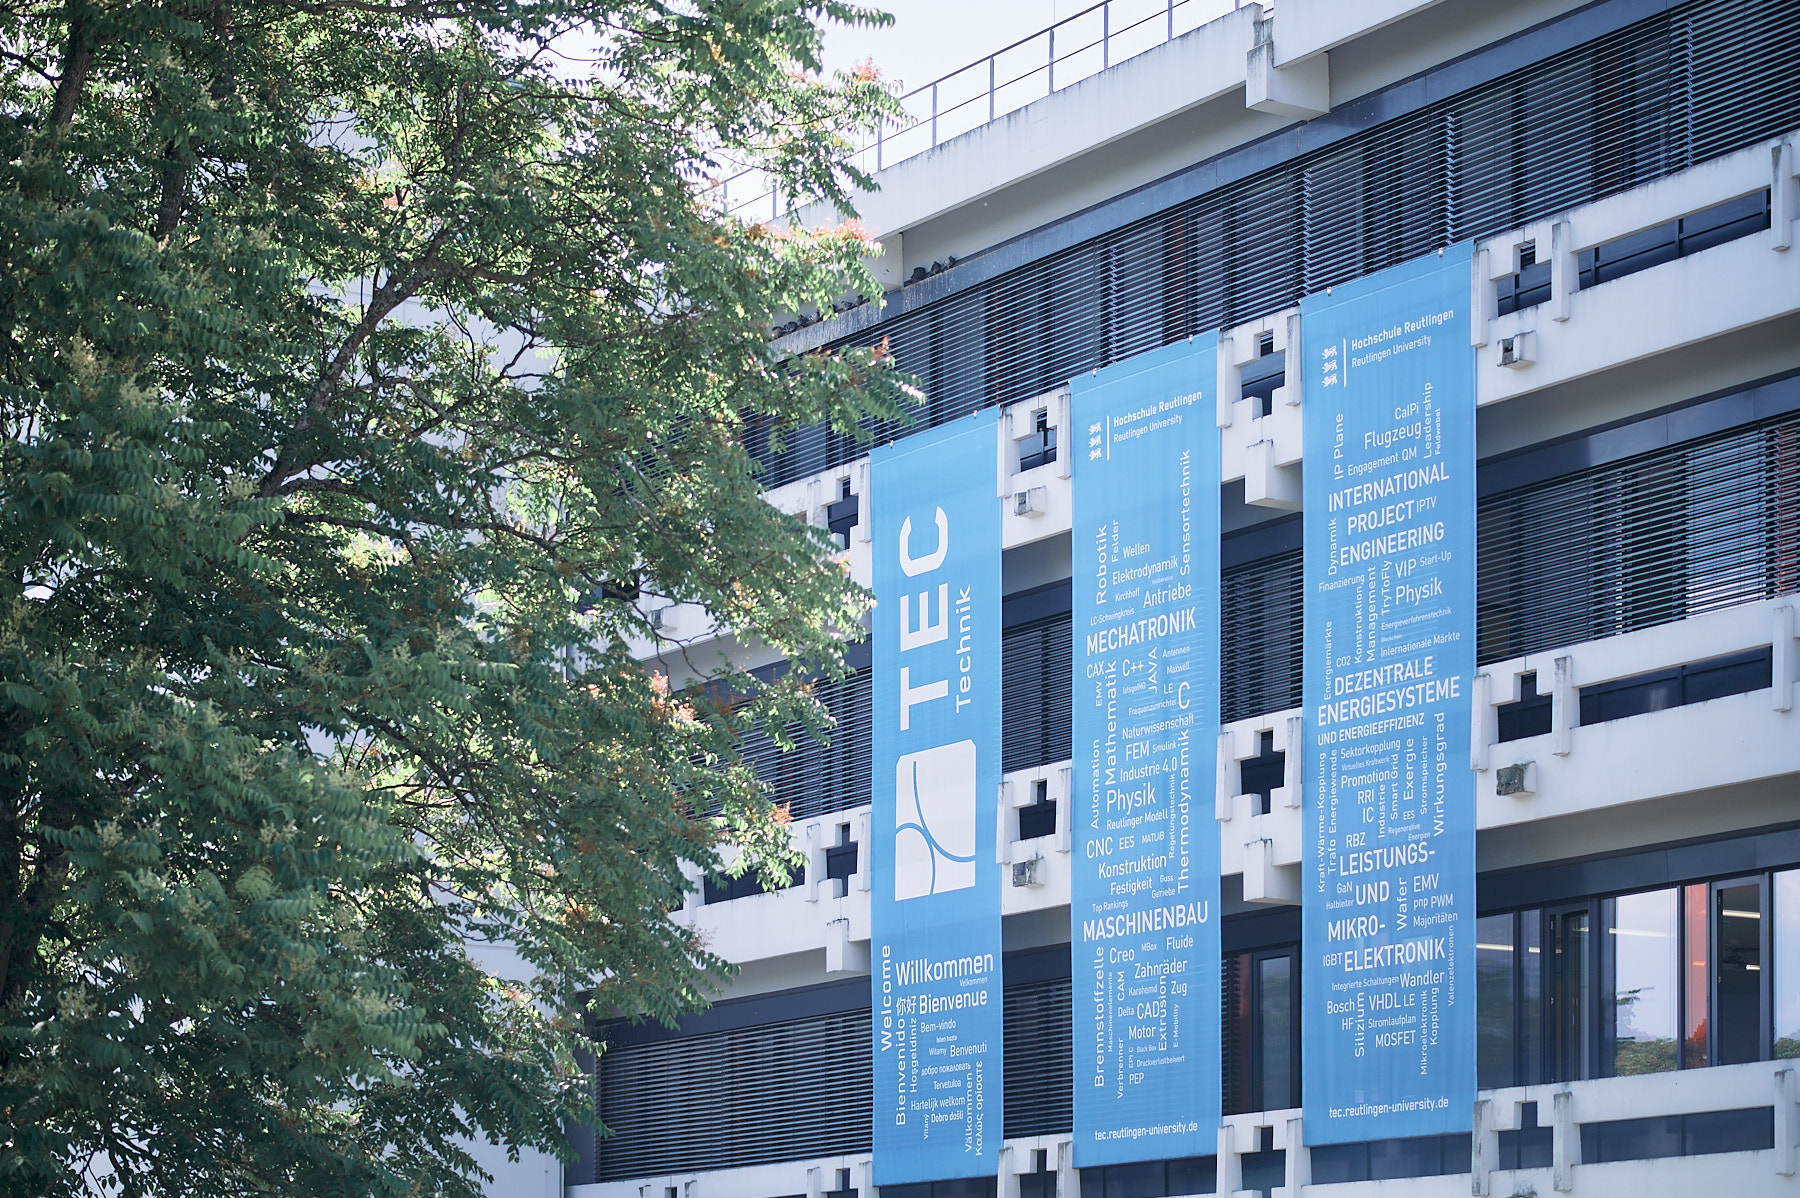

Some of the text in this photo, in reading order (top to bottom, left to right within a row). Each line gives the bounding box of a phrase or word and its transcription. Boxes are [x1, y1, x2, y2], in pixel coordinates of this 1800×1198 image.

[1351, 309, 1454, 350] Hochschule Reutlingen
[1351, 335, 1432, 368] Reutlingen University
[1114, 391, 1202, 427] Hochschule Reutlingen
[1423, 382, 1434, 459] Leadership
[1114, 414, 1183, 443] Reutlingen University
[1364, 421, 1422, 449] Flugzeug
[1334, 413, 1344, 480] IP Plane
[1401, 446, 1417, 461] QM
[1348, 452, 1399, 476] Engagement
[1328, 461, 1450, 512] INTERNATIONAL
[1180, 449, 1190, 576] Sensortechnik
[1416, 496, 1437, 513] IPTV
[1348, 500, 1415, 536] PROJECT
[1123, 543, 1150, 559] Wellen
[1328, 517, 1338, 576] Dynamik
[1340, 521, 1445, 566] ENGINEERING
[1096, 524, 1107, 605] Robotik
[1112, 555, 1178, 585] Elektrodynamik
[1395, 558, 1417, 579] VIP
[1420, 551, 1452, 567] Start-Up
[1115, 587, 1140, 602] Kirchhoff
[1143, 582, 1192, 608] Antriebe
[1318, 574, 1365, 592] Finanzierung
[1381, 560, 1392, 617] TryToFly
[1395, 576, 1443, 606] Physik
[900, 505, 949, 732] TEC
[1354, 586, 1363, 664] Konstruktion
[1366, 566, 1378, 662] Management
[1381, 607, 1452, 631] Energieverfahrenstechnik
[1087, 606, 1196, 657] MECHATRONIK
[956, 584, 971, 714] Technik
[1162, 646, 1190, 659] Antennen
[1380, 632, 1460, 658] Internationale Märkte
[1086, 661, 1104, 679] CAX
[1122, 659, 1144, 677] C++
[1148, 647, 1158, 694] JAVA
[1324, 621, 1334, 701] Energiemärkte
[1334, 655, 1433, 696] DEZENTRALE
[1164, 683, 1174, 695] LE
[1178, 681, 1190, 710] C
[1318, 676, 1460, 727] ENERGIESYSTEME
[1105, 661, 1117, 786] Mathematik
[1122, 713, 1194, 740] Naturwissenschaft
[1317, 712, 1425, 746] UND ENERGIEEFFIZIENZ
[1126, 740, 1150, 761] FEM
[1152, 740, 1177, 753] Simulink
[1340, 739, 1401, 760] Sektorkopplung
[1120, 757, 1178, 782] Industrie 4.0
[1342, 756, 1390, 772] Virtuelles Kraftwerk
[1404, 738, 1416, 801] Exergie
[1421, 736, 1430, 815] Stromspeicher
[1433, 712, 1448, 837] Wirkungsgrad
[1091, 739, 1100, 830] Automation
[1341, 769, 1390, 789] Promotion
[1390, 754, 1398, 820] Smart Grid
[1107, 782, 1156, 816] Physik
[1328, 749, 1339, 834] Energiewende
[1358, 789, 1374, 805] RRI
[1107, 808, 1168, 831] Reutlinger Modell
[1178, 729, 1192, 894] Thermodynamik
[1317, 752, 1327, 893] Kraft-Wärme-Kopplung
[1362, 806, 1374, 824] IC
[1378, 784, 1386, 838] Industrie
[1403, 810, 1415, 821] EES
[1142, 831, 1165, 844] MATLAB
[1346, 832, 1366, 848] RBZ
[1388, 823, 1420, 835] Regenerative
[1408, 831, 1431, 842] Energien
[1086, 837, 1113, 859] CNC
[1119, 836, 1135, 850] EES
[1098, 853, 1167, 880] Konstruktion
[1328, 840, 1337, 875] Trafo
[1340, 841, 1436, 877] LEISTUNGS-
[1111, 876, 1152, 896] Festigkeit
[1152, 888, 1176, 899] Getriebe
[1336, 881, 1353, 894] GaN
[1355, 880, 1390, 906] UND
[1413, 873, 1440, 893] EMV
[1092, 900, 1129, 914] Top Rankings
[1397, 877, 1408, 931] Wafer
[1413, 897, 1428, 911] pnp
[1430, 894, 1454, 909] PWM
[1084, 900, 1208, 942] MASCHINENBAU
[1328, 915, 1386, 942] MIKRO-
[1413, 912, 1458, 928] Majoritäten
[1166, 934, 1194, 950] Fluide
[1109, 947, 1135, 964] Creo
[1323, 953, 1343, 968] IGBT
[1344, 937, 1446, 972] ELEKTRONIK
[895, 953, 994, 986] Willkommen
[1134, 958, 1188, 979] Zahnräder
[1400, 970, 1445, 988] Wandler
[1171, 980, 1187, 996] Zug
[1332, 976, 1399, 992] Integrierte Schaltungen
[881, 945, 892, 1052] Welcome
[896, 995, 917, 1016] 你好
[919, 990, 988, 1015] Bienvenue
[1137, 1000, 1160, 1020] CAD
[1327, 999, 1354, 1014] Bosch
[1369, 992, 1402, 1011] VHDL
[1404, 994, 1416, 1007] LE
[1094, 947, 1104, 1087] Brennstoffzelle
[1118, 1006, 1134, 1017] Delta
[1158, 975, 1167, 1051] Extrusion
[1342, 1017, 1354, 1030] HF
[1368, 1014, 1416, 1029] Stromlaufplan
[1430, 987, 1440, 1046] Kopplung
[920, 1018, 956, 1033] Bem-vindo
[1128, 1025, 1156, 1040] Motor
[1355, 992, 1365, 1058] Silizium
[950, 1041, 988, 1058] Benvenuti
[1375, 1030, 1416, 1048] MOSFET
[929, 1047, 947, 1056] Witamy
[896, 1018, 906, 1126] Bienvenido
[1129, 1073, 1144, 1085] PEP
[933, 1079, 962, 1090] Tervetuloa
[910, 1096, 966, 1112] Hartelijk welkom
[965, 1072, 973, 1153] Välkommen
[1329, 1096, 1449, 1119] tec.reutlingen-university.de
[931, 1110, 964, 1123] Dobro došli
[976, 1113, 984, 1156] Καλώς
[1095, 1121, 1198, 1141] tec.reutlingen-university.de
